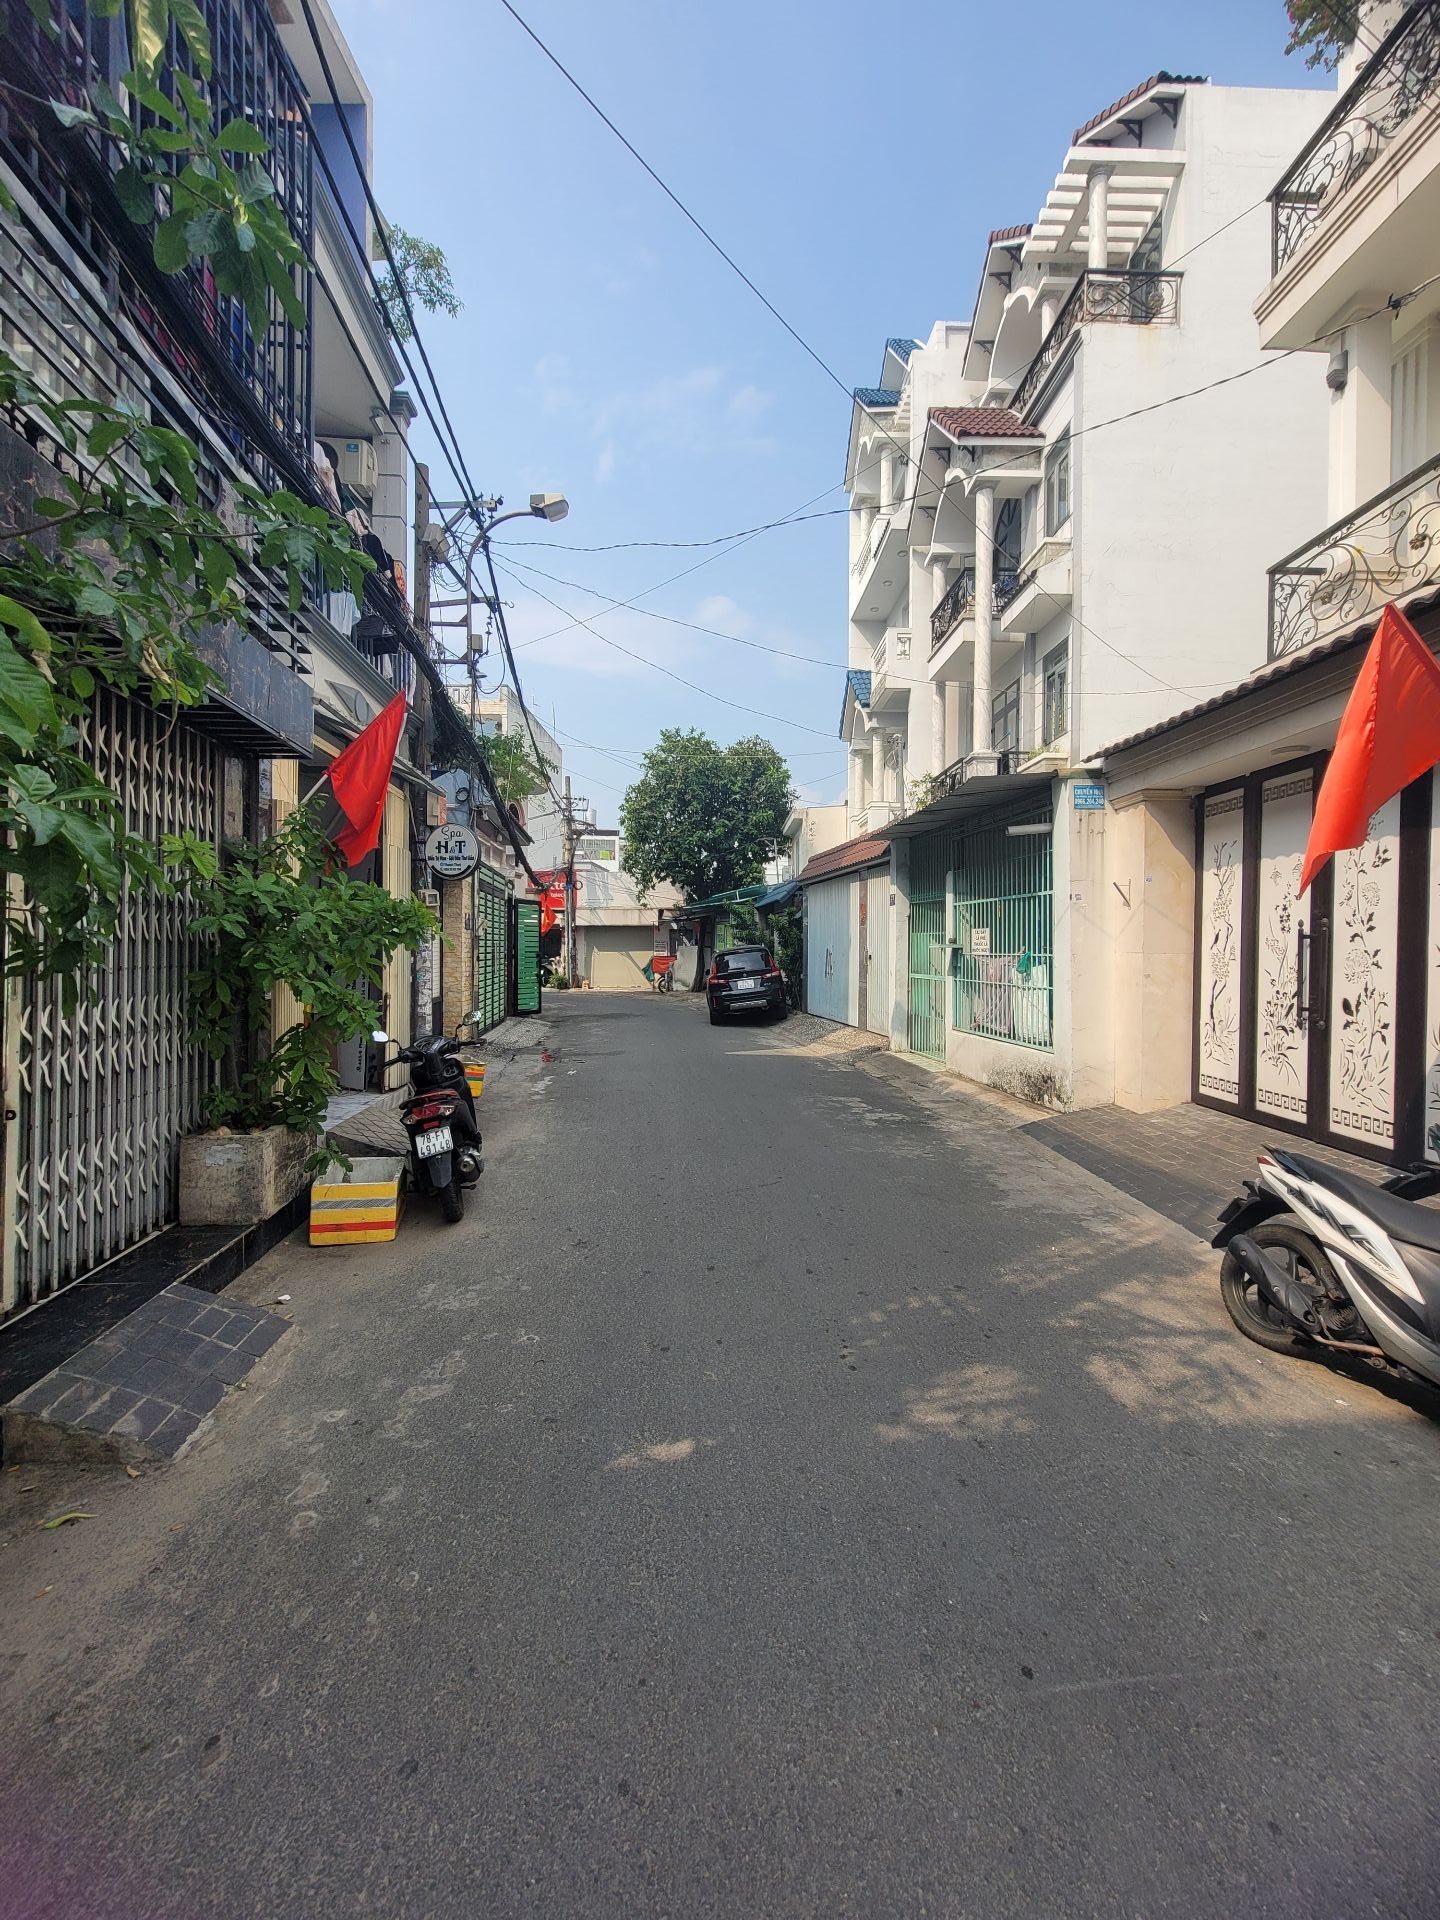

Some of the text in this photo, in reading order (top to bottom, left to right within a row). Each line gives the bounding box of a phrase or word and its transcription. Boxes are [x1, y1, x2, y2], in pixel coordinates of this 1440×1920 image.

[441, 826, 463, 840] Spa
[435, 840, 466, 853] H&T
[421, 1130, 445, 1145] 78-F1
